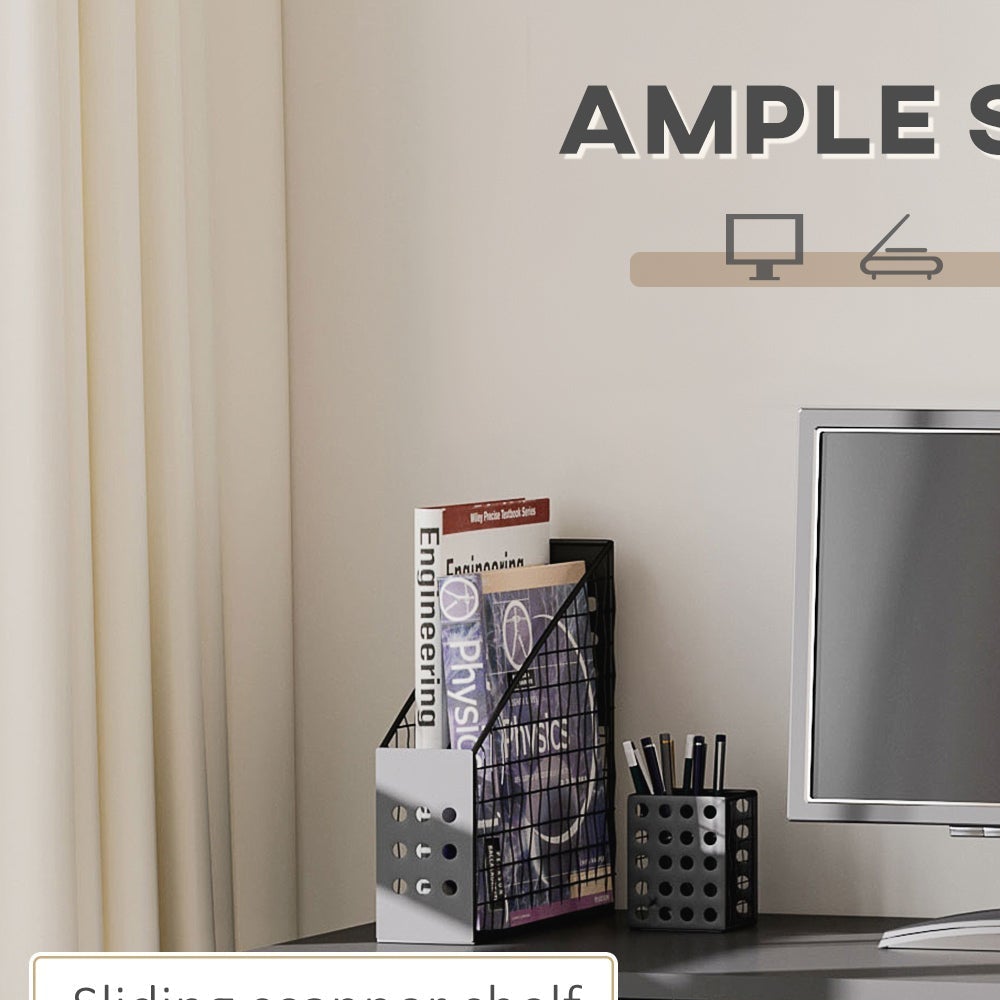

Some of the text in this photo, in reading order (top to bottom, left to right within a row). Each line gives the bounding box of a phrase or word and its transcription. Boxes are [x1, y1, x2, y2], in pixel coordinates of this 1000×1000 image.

[501, 508, 521, 519] Textbook
[522, 506, 536, 517] Series
[417, 527, 440, 727] Engineering
[447, 639, 486, 764] Physic
